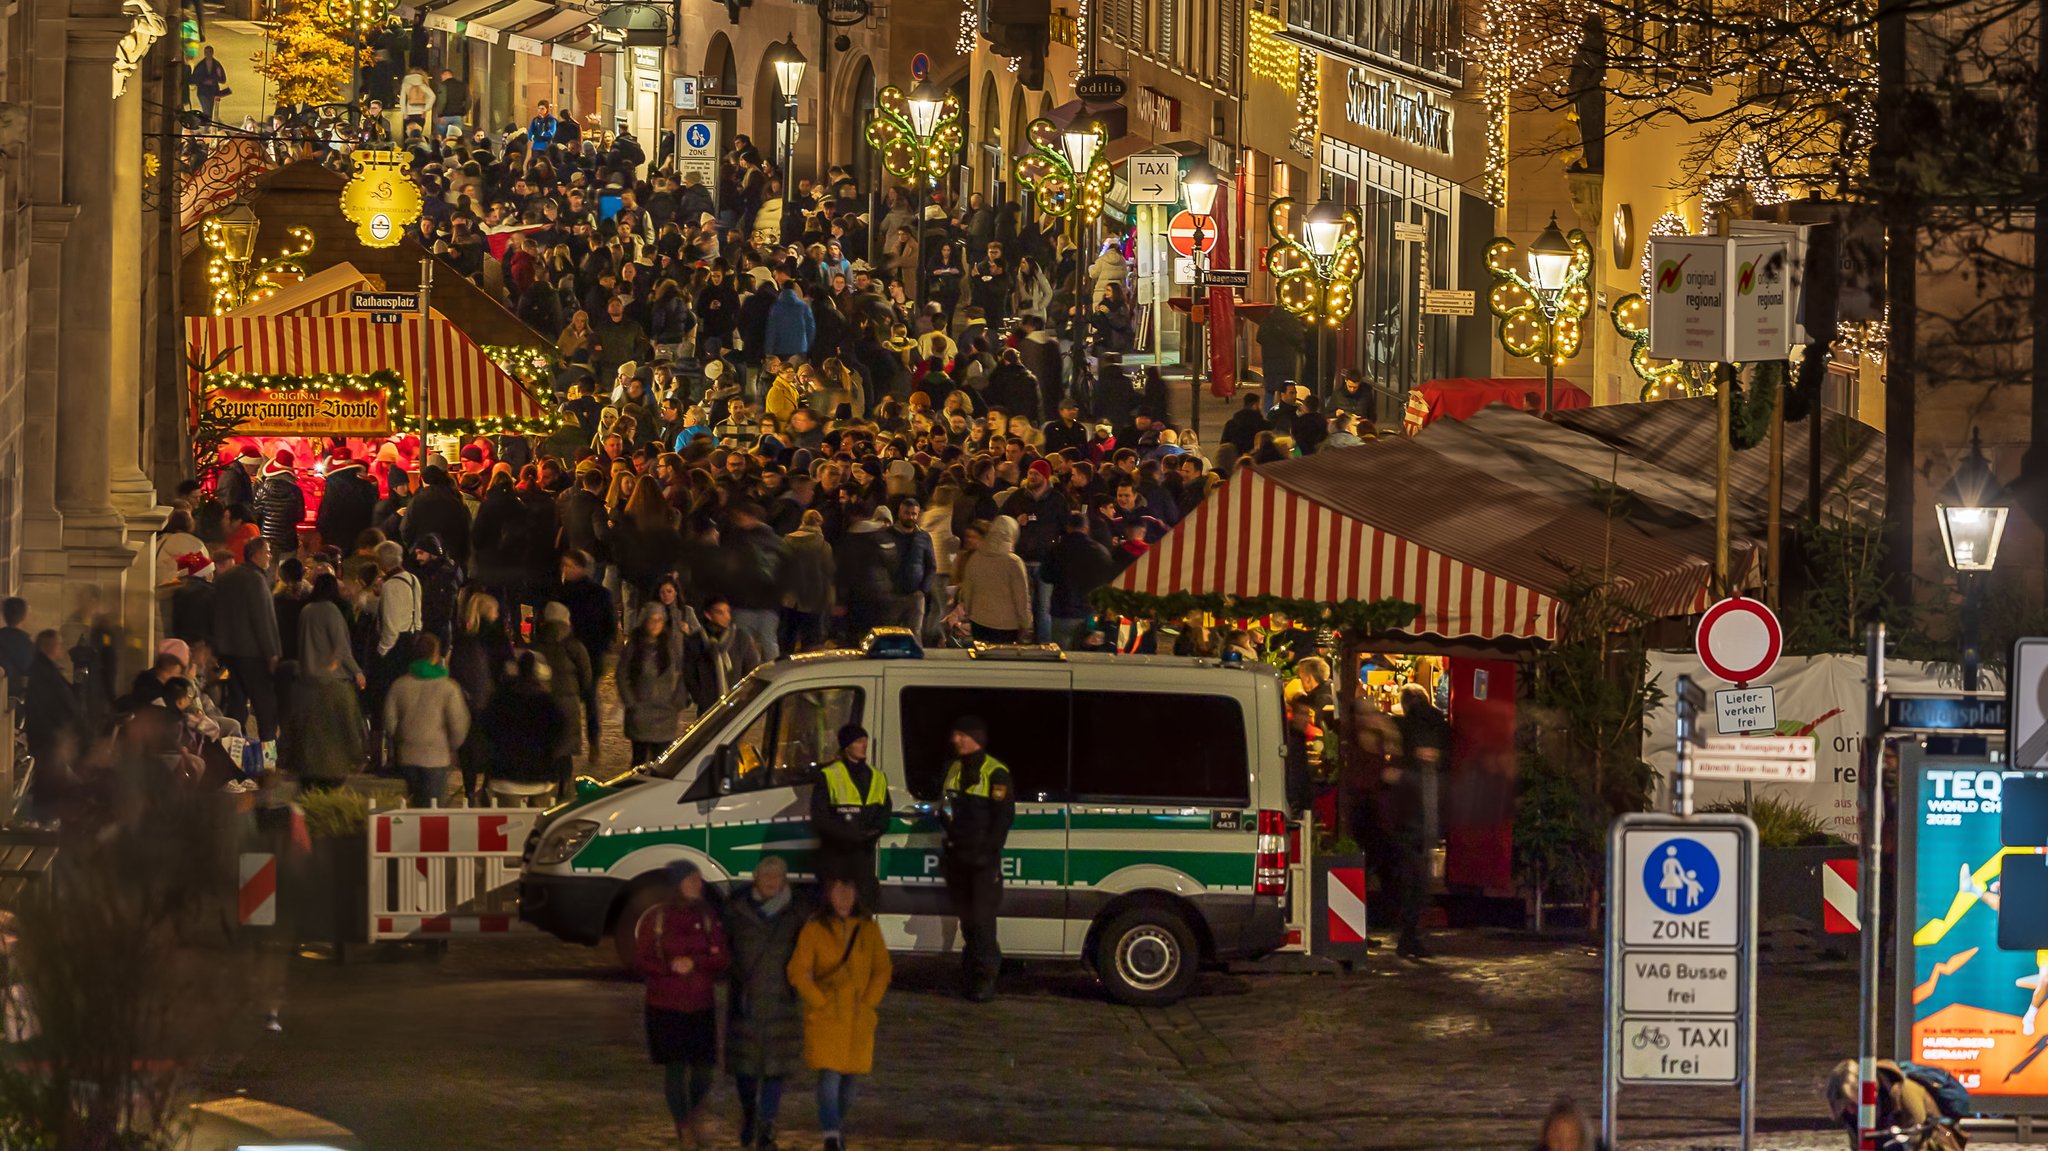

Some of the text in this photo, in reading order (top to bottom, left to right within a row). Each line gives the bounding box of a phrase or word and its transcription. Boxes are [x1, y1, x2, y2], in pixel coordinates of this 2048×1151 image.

[1080, 82, 1121, 93] odilia
[1137, 163, 1169, 175] TAXI
[1686, 270, 1716, 289] original
[355, 295, 415, 309] Rathausplatz
[1685, 291, 1721, 310] regional
[1757, 290, 1784, 310] regional
[376, 314, 381, 323] 6
[389, 314, 397, 323] 10
[269, 392, 321, 401] ORIGINAL
[1726, 693, 1763, 704] Liefer-
[1725, 704, 1767, 716] verkehr
[1901, 701, 2006, 727] Rathausplat
[1737, 717, 1756, 727] frei
[1833, 731, 1861, 753] ori
[1926, 770, 2024, 801] TEQ
[1927, 800, 2002, 814] WORLD CH
[1220, 811, 1233, 819] BY
[1926, 814, 1962, 826] 2022
[1216, 821, 1237, 829] 4431
[1652, 920, 1711, 940] ZONE
[1635, 962, 1728, 981] VAG Busse
[1667, 987, 1696, 1004] frei
[1677, 1027, 1729, 1048] TAXI
[1922, 1049, 1980, 1061] GERMANY
[1660, 1054, 1700, 1075] frei
